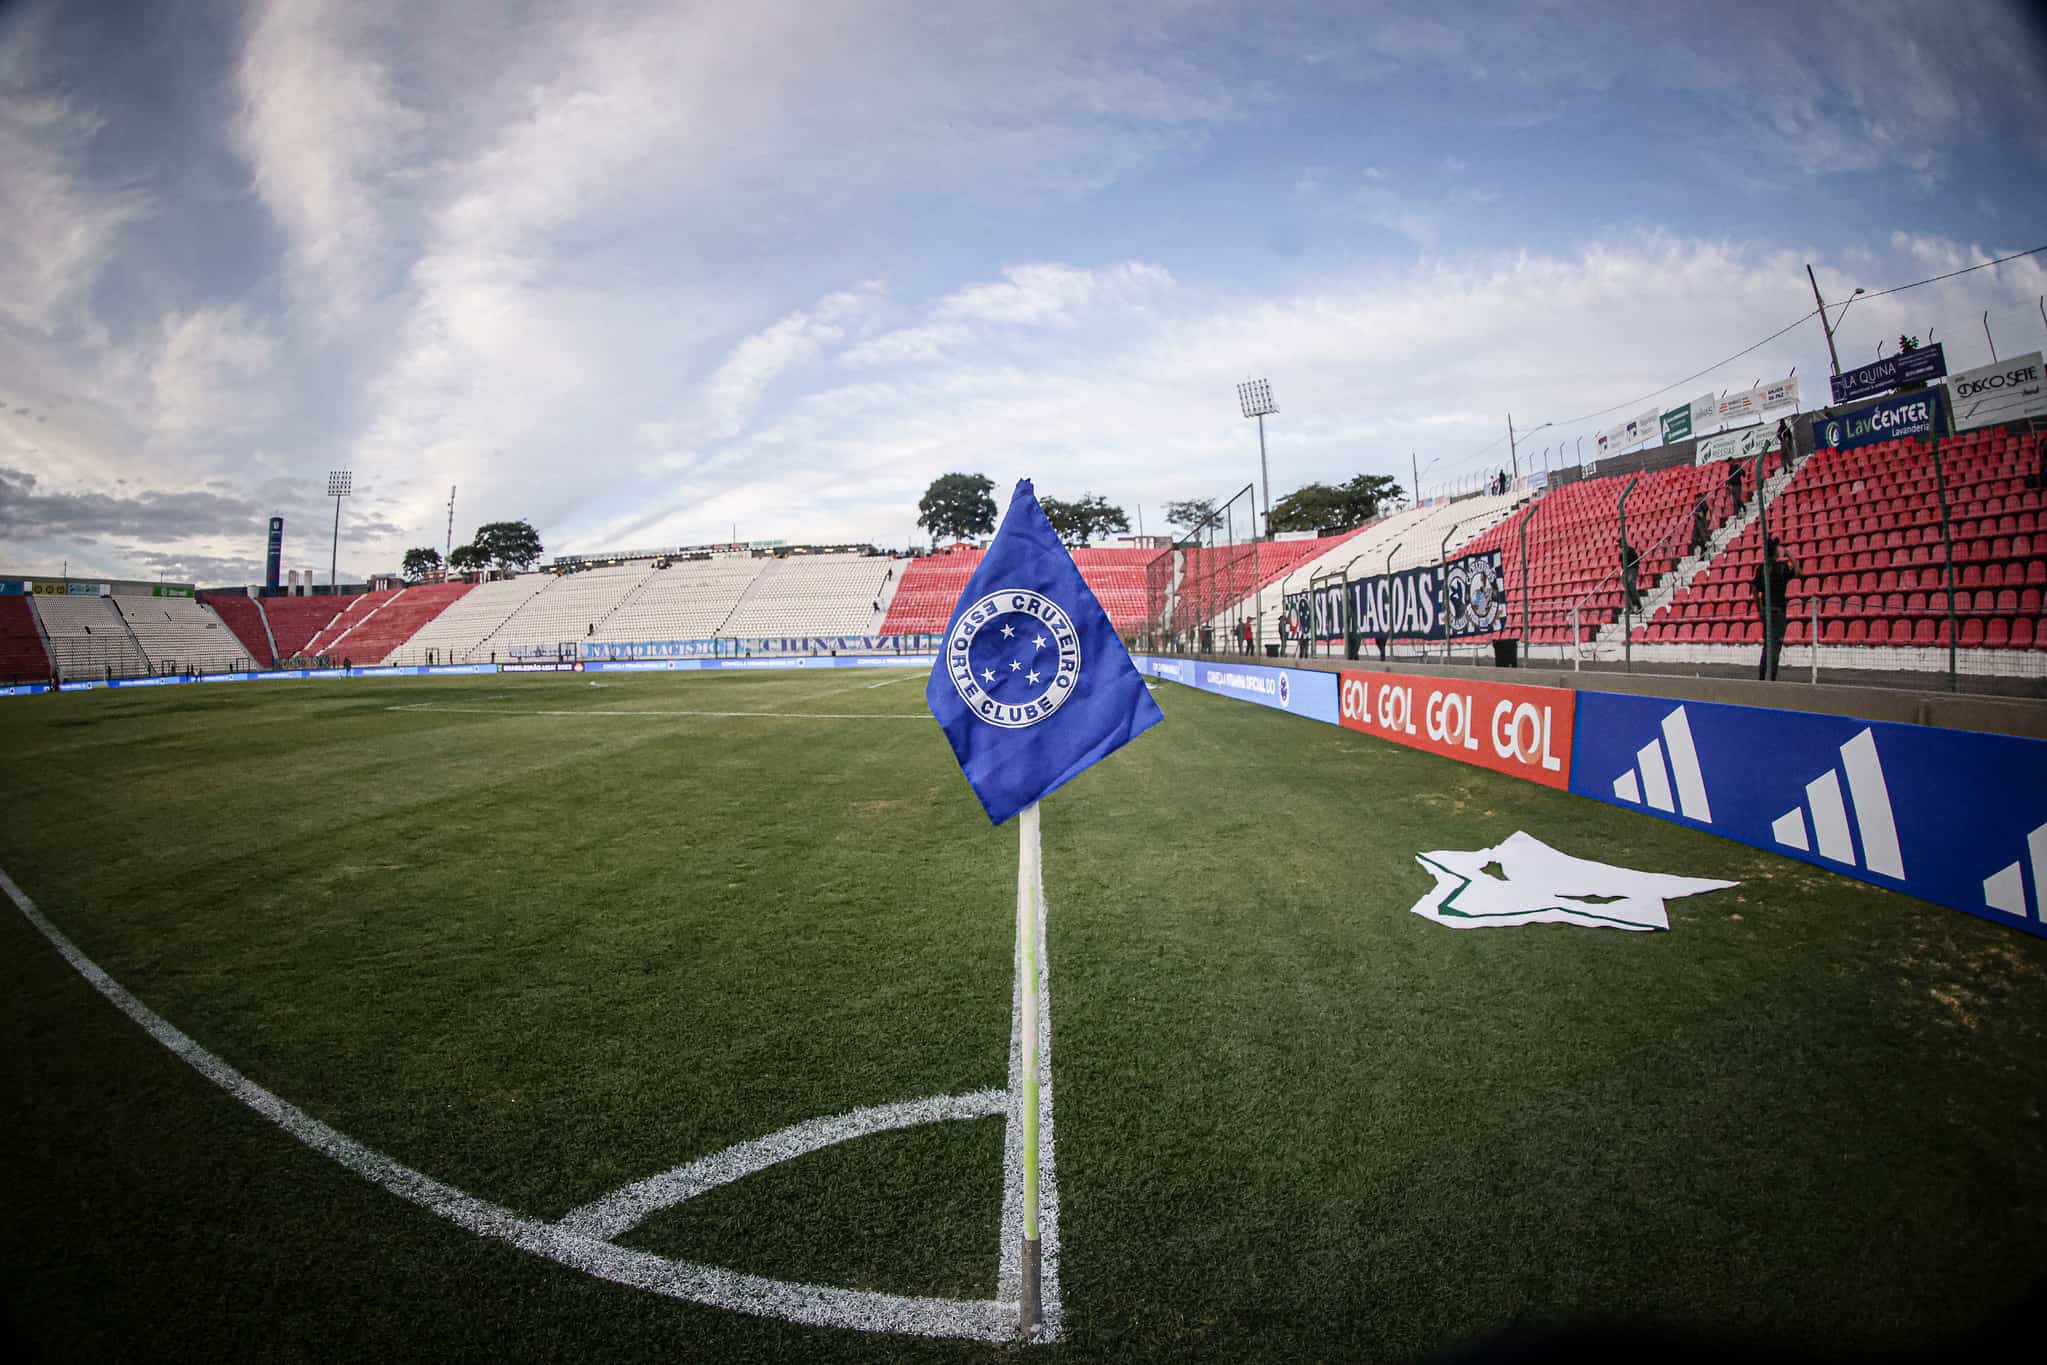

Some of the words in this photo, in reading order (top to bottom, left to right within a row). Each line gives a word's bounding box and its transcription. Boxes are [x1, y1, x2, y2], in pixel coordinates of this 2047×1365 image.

[1859, 362, 1896, 384] QUINA
[1892, 422, 1930, 437] Lavanderia
[1315, 587, 1352, 634] SET
[1355, 572, 1434, 634] LAGOAS
[951, 600, 998, 698] ESPORTE
[1011, 595, 1076, 689] CRUZEIRO
[981, 695, 1054, 722] CLUBE
[1342, 679, 1372, 724] GOL
[1378, 684, 1416, 735] GOL
[1425, 690, 1479, 750] GOL
[1491, 699, 1561, 772] GOL
